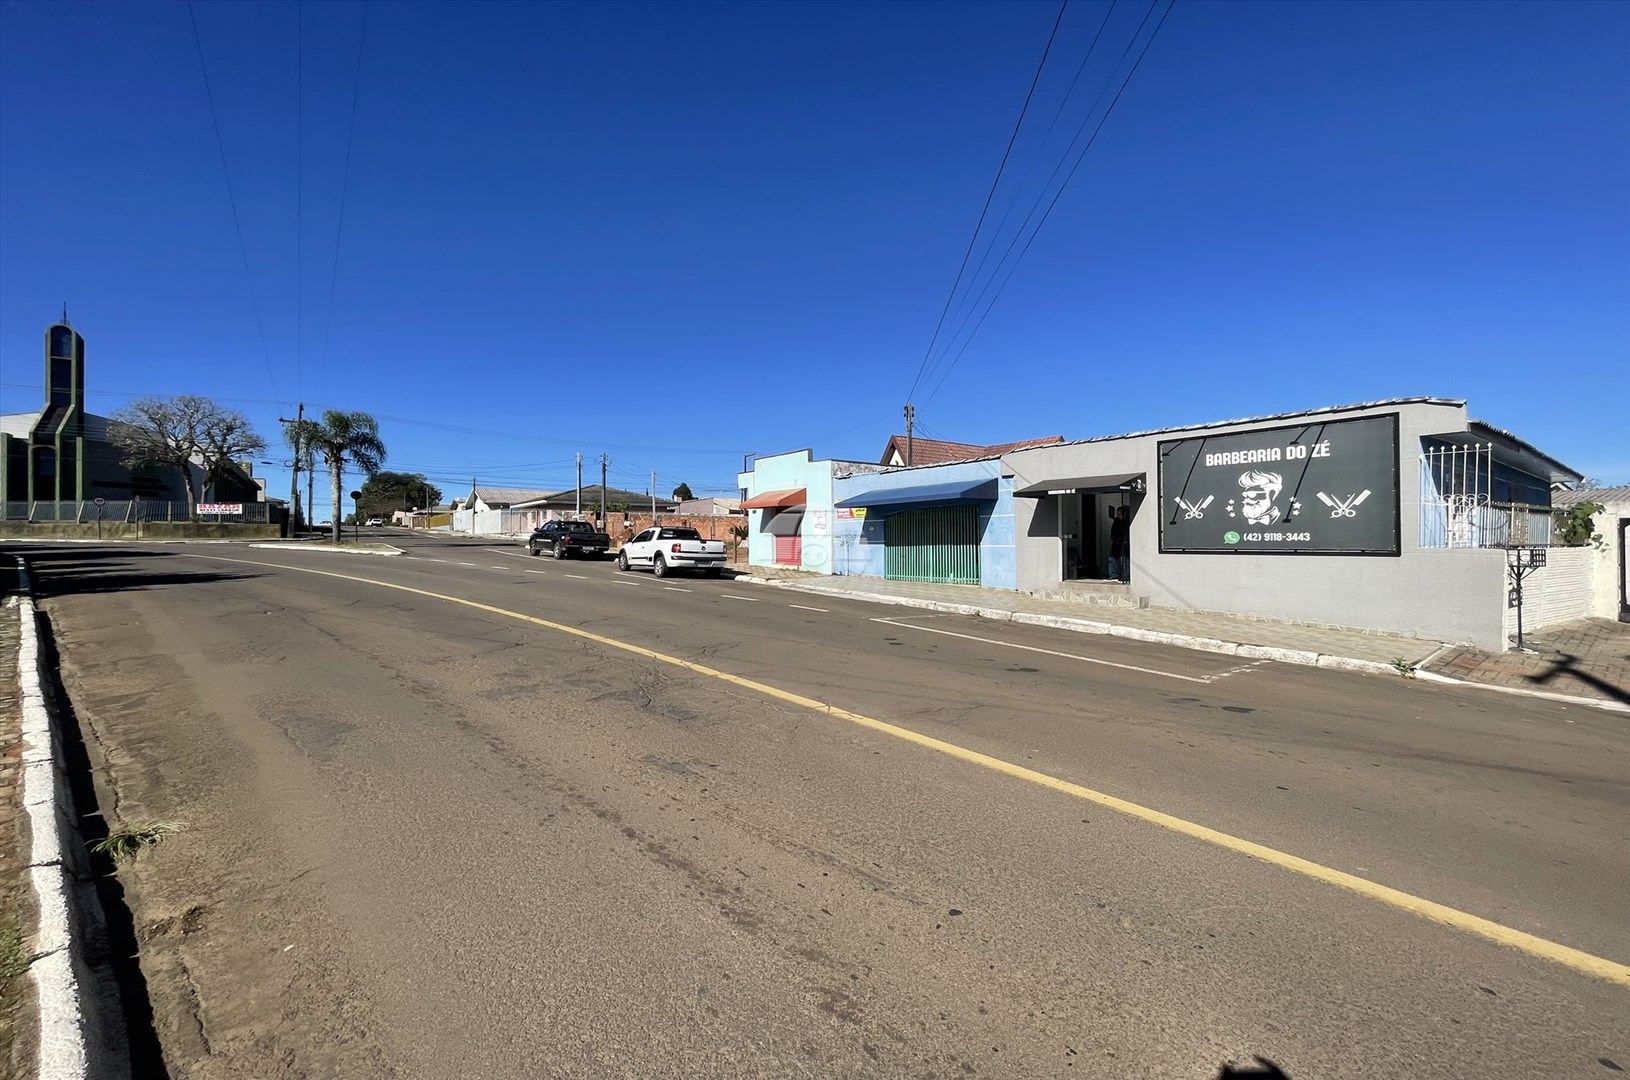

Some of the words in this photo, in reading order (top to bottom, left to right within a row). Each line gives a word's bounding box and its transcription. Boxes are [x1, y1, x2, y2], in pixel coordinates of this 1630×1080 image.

[1205, 448, 1281, 466] BARBEARIA
[1286, 445, 1307, 460] DO
[1311, 440, 1331, 458] ZÉ
[1243, 532, 1262, 542] (42)
[1263, 532, 1311, 542] 9118-3443
